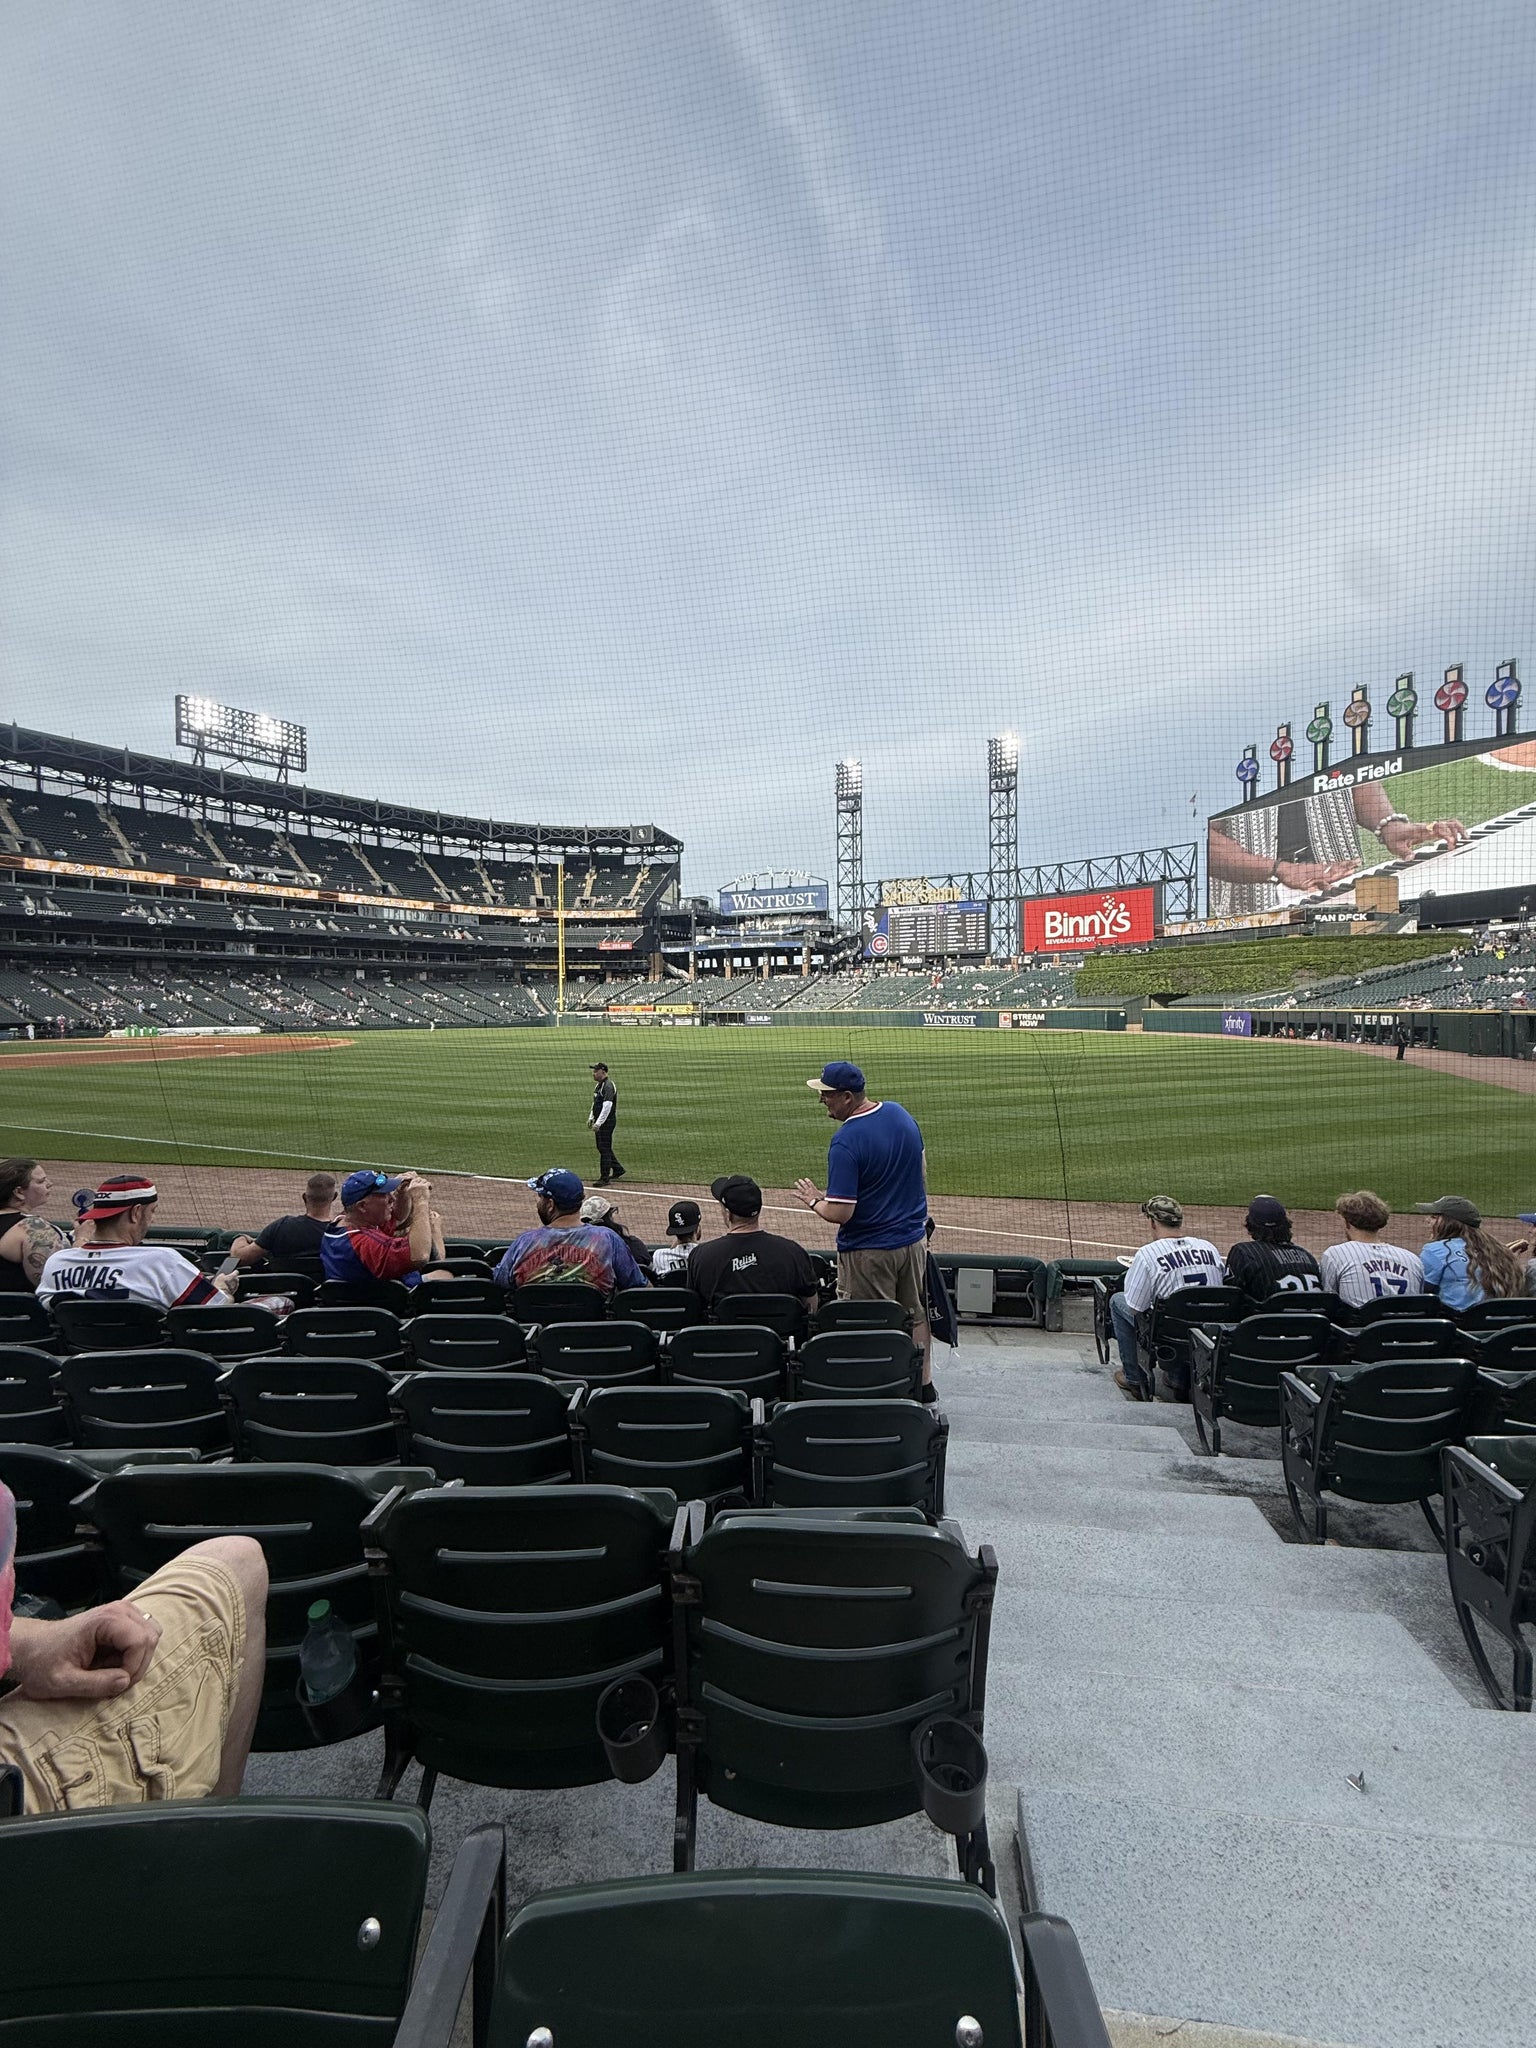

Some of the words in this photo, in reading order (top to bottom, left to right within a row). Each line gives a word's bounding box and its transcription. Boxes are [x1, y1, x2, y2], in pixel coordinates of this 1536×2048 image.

[1313, 774, 1355, 793] Rate
[1357, 757, 1403, 782] Field
[734, 871, 760, 884] KIDS
[781, 868, 811, 880] ZONE
[731, 892, 818, 909] WINTRUST
[1315, 913, 1337, 922] FAN
[1045, 937, 1075, 945] BEVERAGE
[923, 1013, 976, 1025] WINTRUST
[1012, 1013, 1046, 1021] STREAM
[1224, 1015, 1246, 1033] xfinity
[731, 1252, 758, 1272] Relish
[1156, 1249, 1217, 1273] SWANSON
[1362, 1259, 1409, 1278] BRYANT
[52, 1265, 124, 1291] THOMAS
[1369, 1276, 1408, 1296] 17
